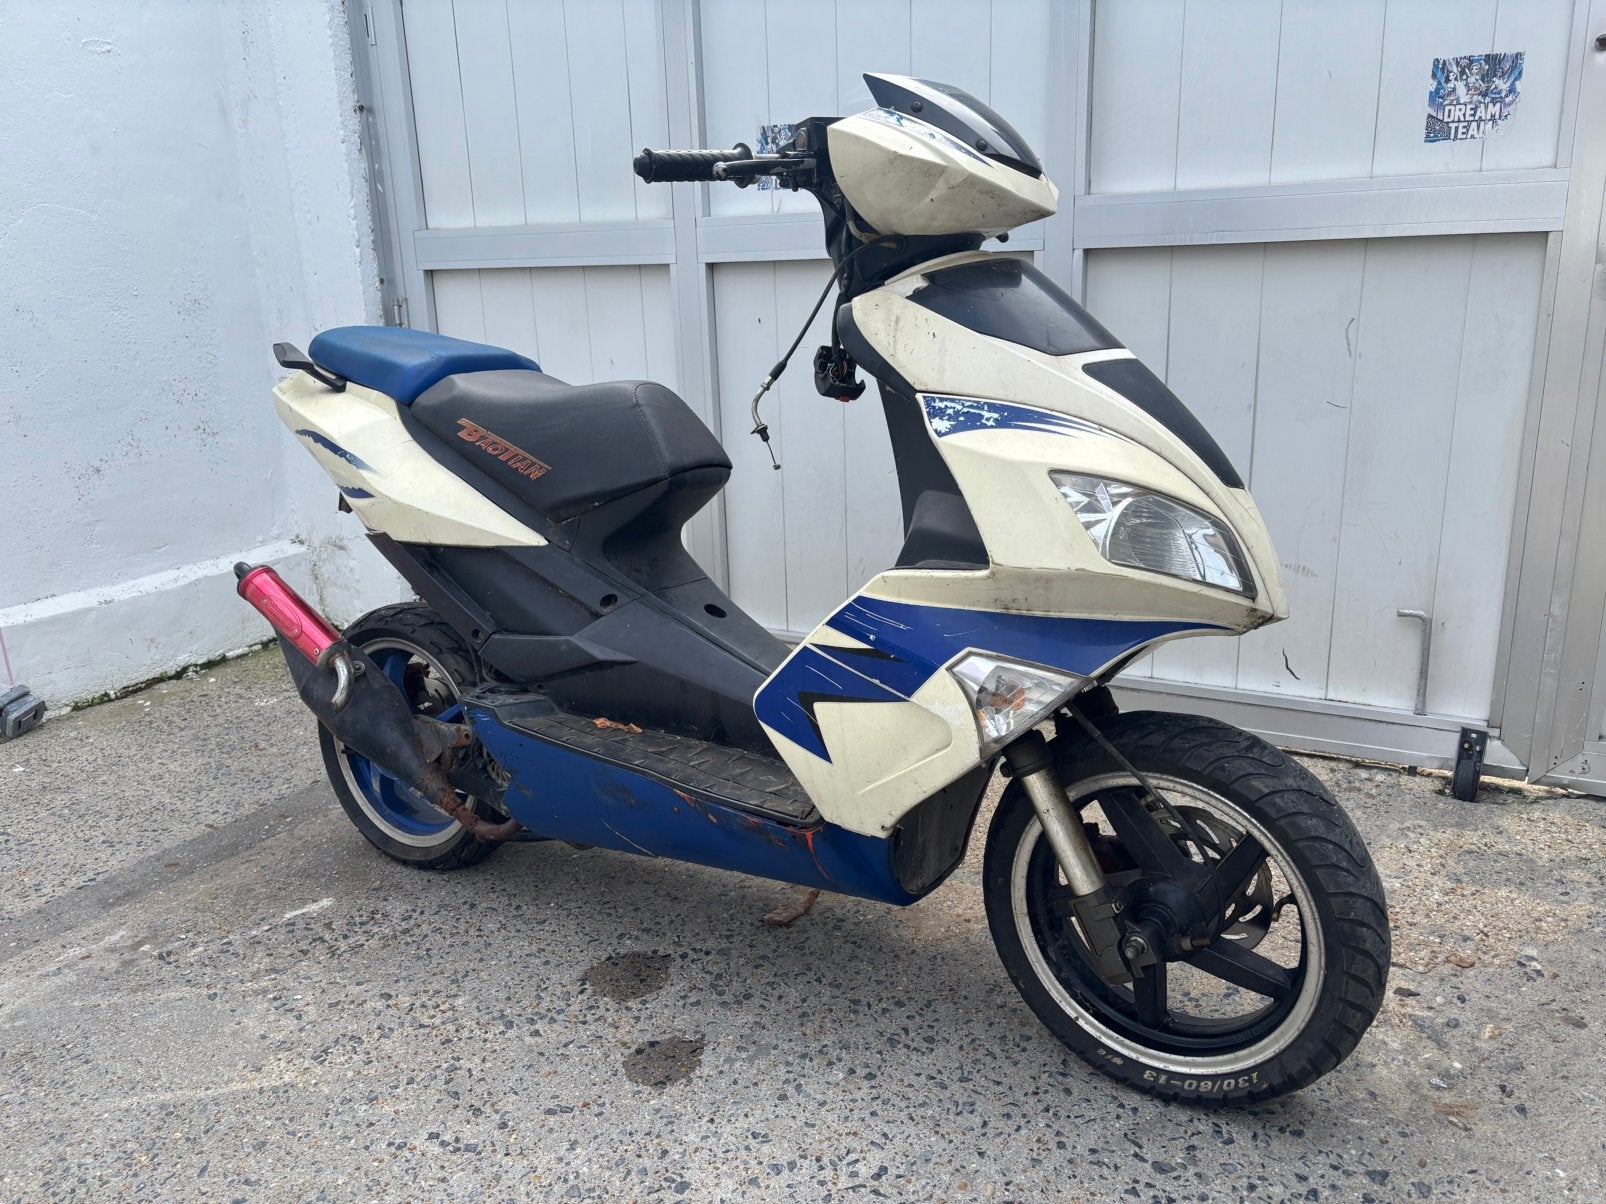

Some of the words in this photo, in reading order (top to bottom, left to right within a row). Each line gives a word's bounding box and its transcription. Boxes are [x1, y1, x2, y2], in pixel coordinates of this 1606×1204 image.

[1443, 102, 1501, 122] DREAM
[457, 418, 551, 480] BAOTIAN
[1143, 1070, 1259, 1092] 130/60-13
